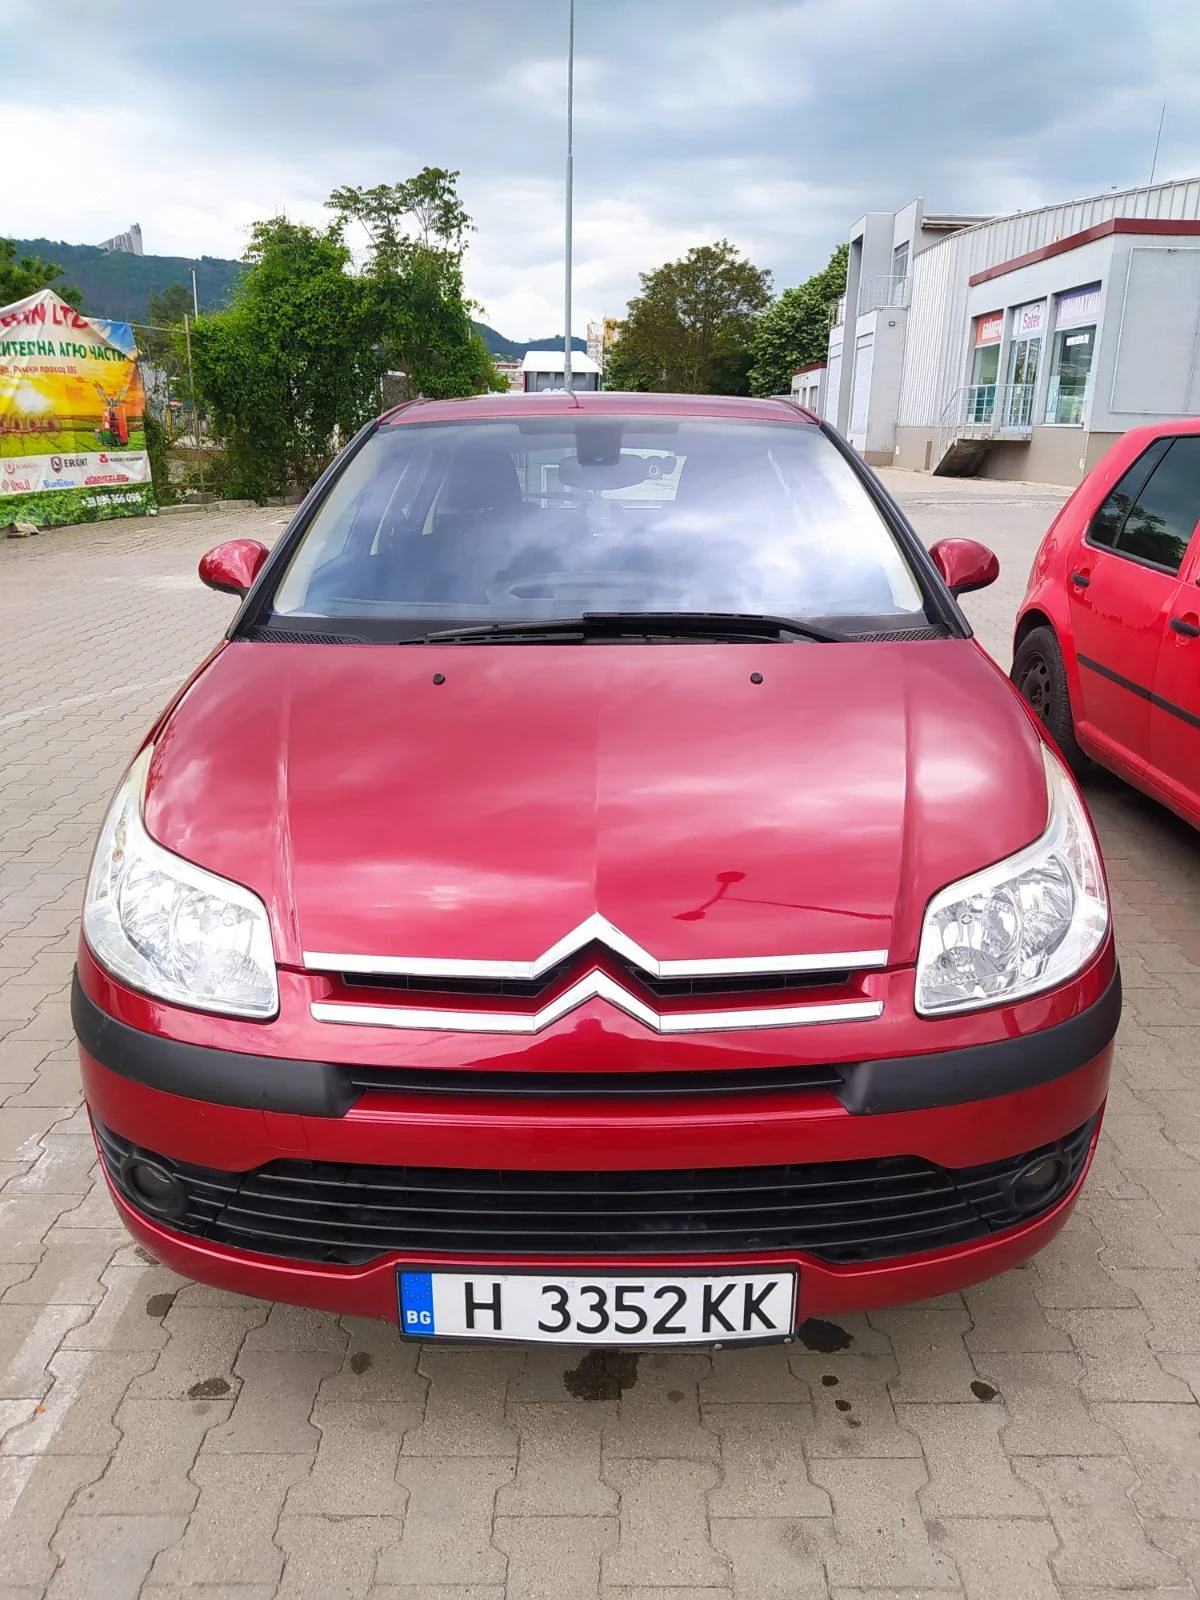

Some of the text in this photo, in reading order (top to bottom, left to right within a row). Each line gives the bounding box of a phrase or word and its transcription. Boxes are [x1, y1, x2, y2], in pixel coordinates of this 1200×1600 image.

[36, 340, 56, 357] НА
[464, 1281, 502, 1331] H
[406, 1309, 431, 1325] BG
